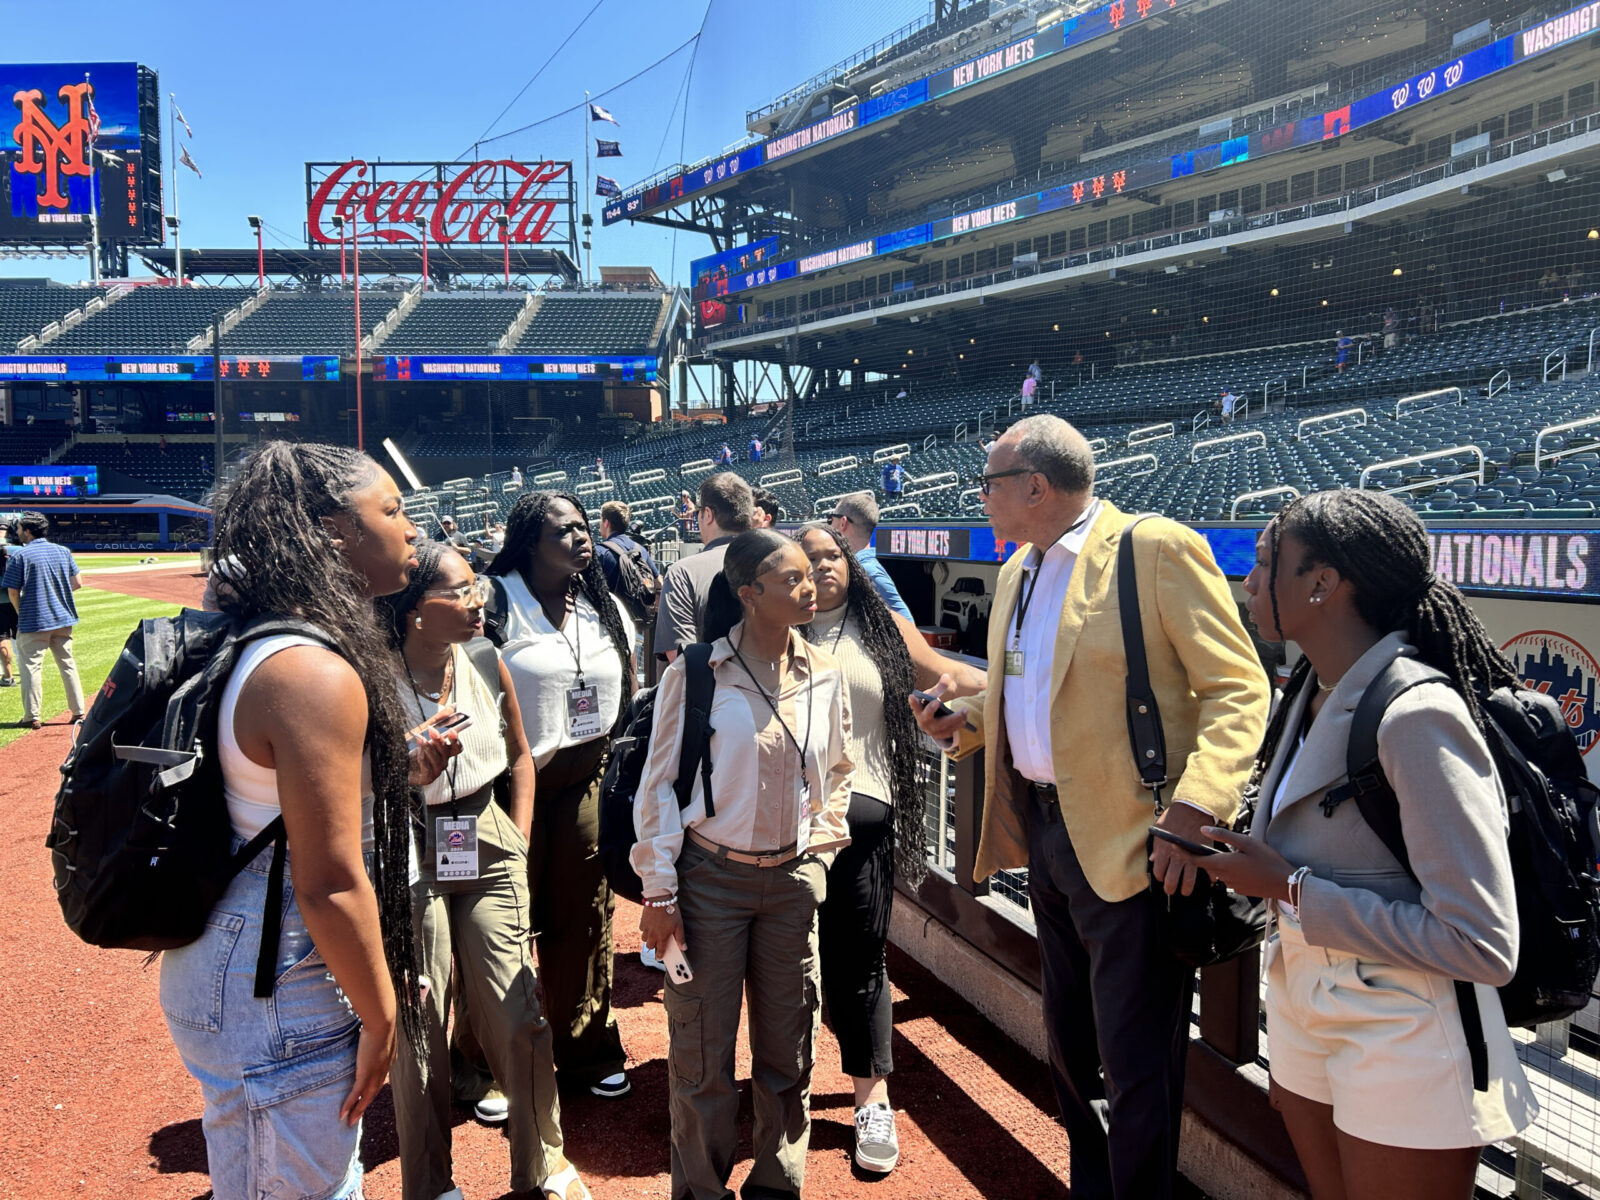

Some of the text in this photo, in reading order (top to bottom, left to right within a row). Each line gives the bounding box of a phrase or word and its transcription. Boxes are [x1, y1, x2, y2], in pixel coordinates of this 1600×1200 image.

[953, 38, 1035, 88] NEW YORK METS
[766, 110, 854, 160] WASHINGTON NATIONALS
[307, 159, 572, 244] Coca-Cola
[38, 213, 82, 223] NEW YORK METS
[952, 202, 1016, 233] NEW YORK METS
[800, 240, 873, 273] WASHINGTON NATIONALS
[28, 363, 67, 374] NATIONALS
[121, 363, 178, 374] NEW YORK METS
[422, 363, 501, 374] WASHINGTON NATIONALS
[543, 363, 596, 374] NEW YORK METS
[23, 476, 72, 485] NEW YORK METS
[890, 530, 950, 557] NEW YORK METS
[571, 689, 593, 700] MEDIA
[443, 820, 470, 831] MEDIA
